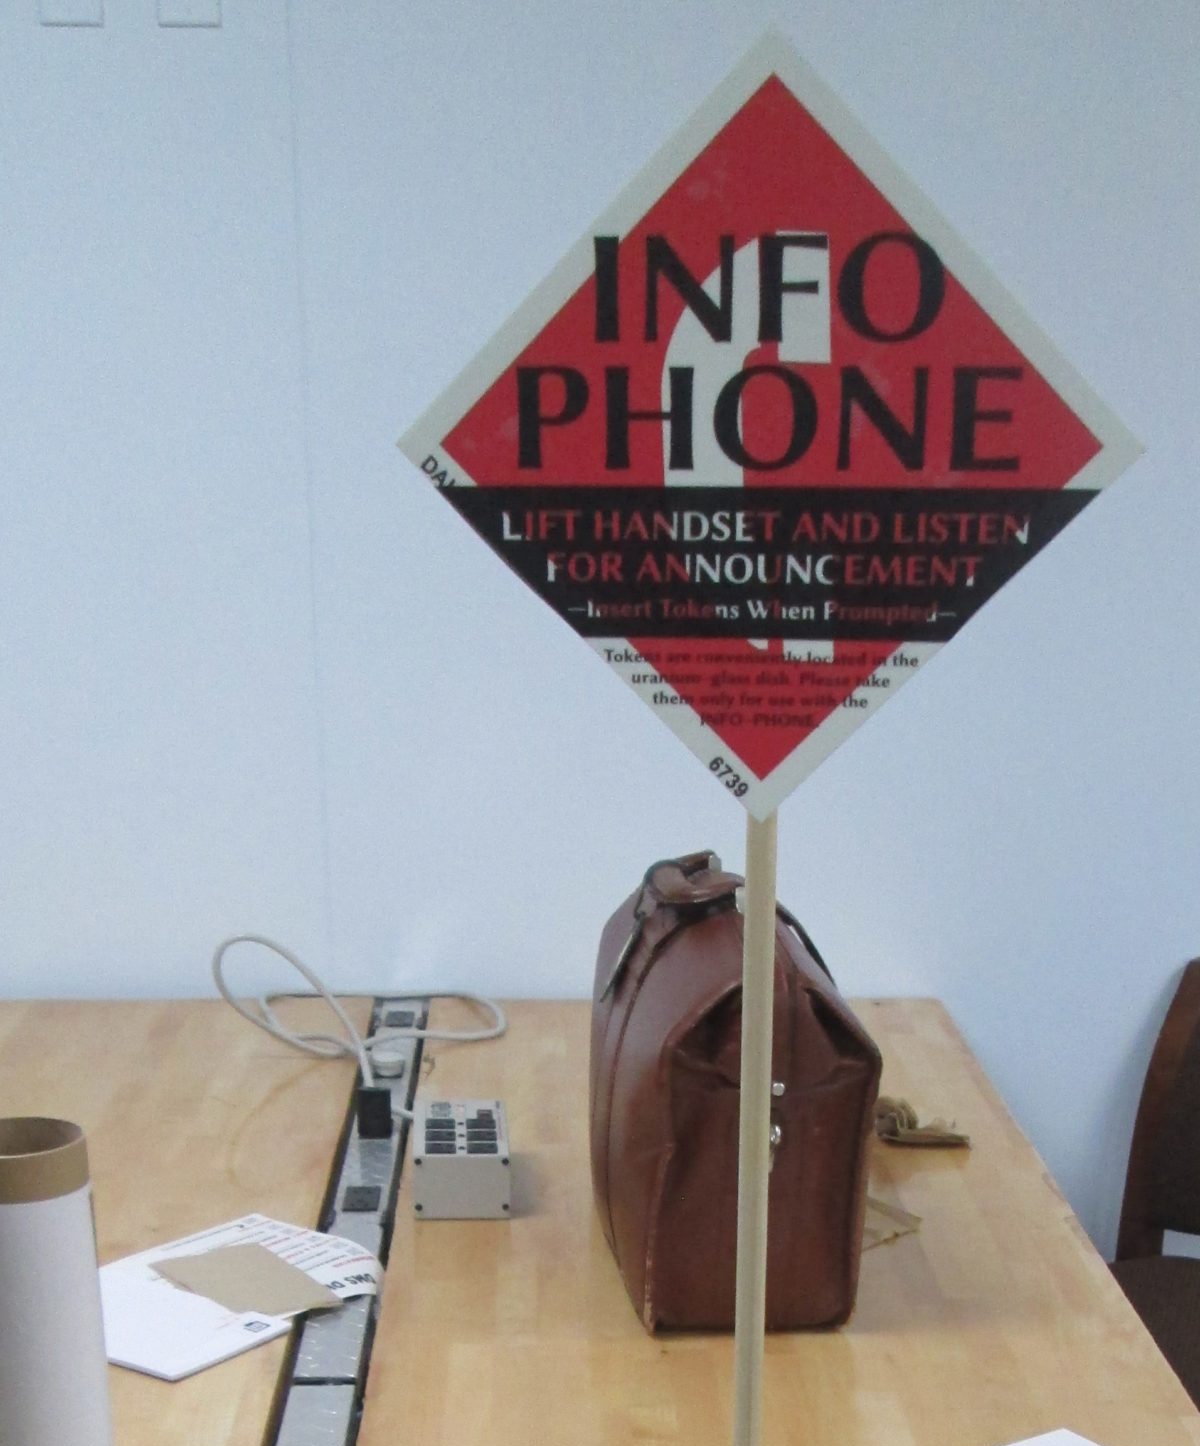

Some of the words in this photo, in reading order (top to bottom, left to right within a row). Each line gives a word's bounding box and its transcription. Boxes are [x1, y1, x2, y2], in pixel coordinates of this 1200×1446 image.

[594, 231, 946, 344] INFO
[515, 364, 1024, 471] PHONE
[502, 509, 581, 542] LIFT
[594, 510, 781, 543] HANDSET
[791, 512, 880, 544] AND
[893, 513, 1030, 544] LISTEN
[547, 552, 625, 583] FOR
[636, 552, 984, 587] ANNOUNCEMENT
[661, 598, 739, 619] Tokens
[746, 599, 814, 620] When
[893, 652, 919, 667] the
[652, 690, 694, 705] them
[842, 694, 868, 709] the
[709, 756, 748, 797] 6739
